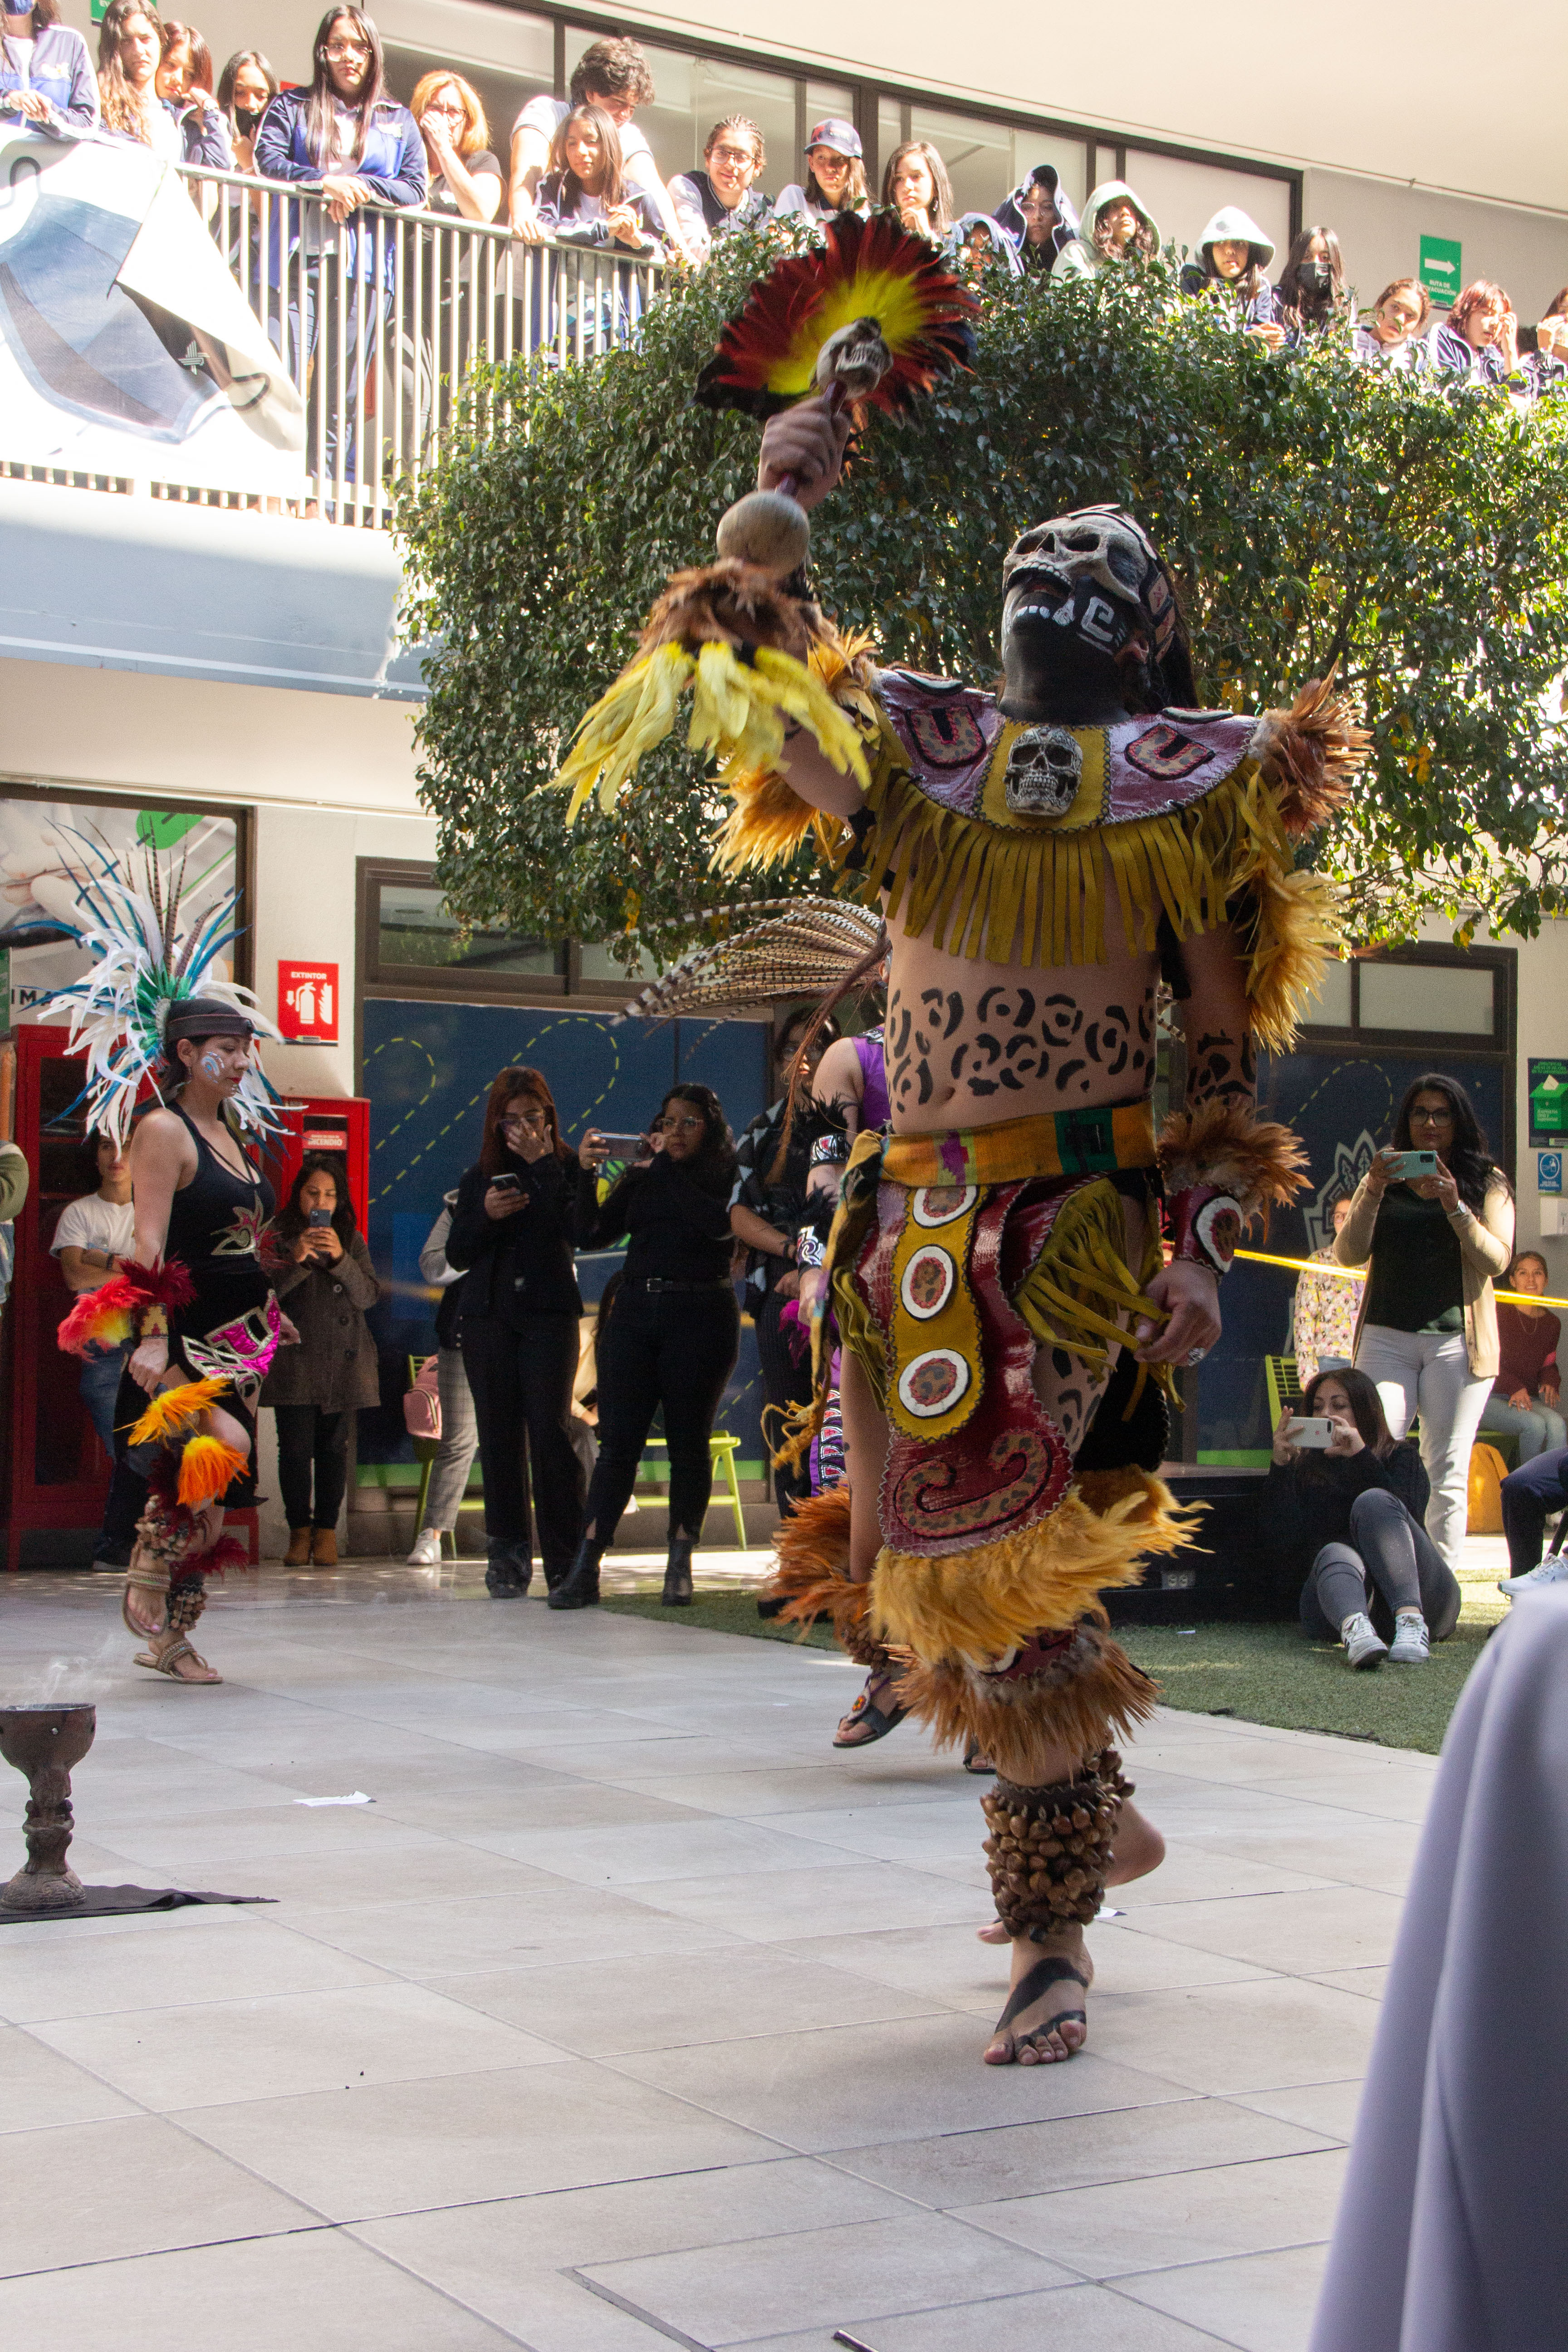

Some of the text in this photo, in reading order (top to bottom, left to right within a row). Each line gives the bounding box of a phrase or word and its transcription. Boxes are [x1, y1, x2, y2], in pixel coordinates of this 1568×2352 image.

[1430, 279, 1442, 287] RUTA
[1427, 286, 1456, 296] VACUACIÓN
[291, 971, 327, 980] EXTINTOR
[308, 1138, 343, 1146] INCENDIO
